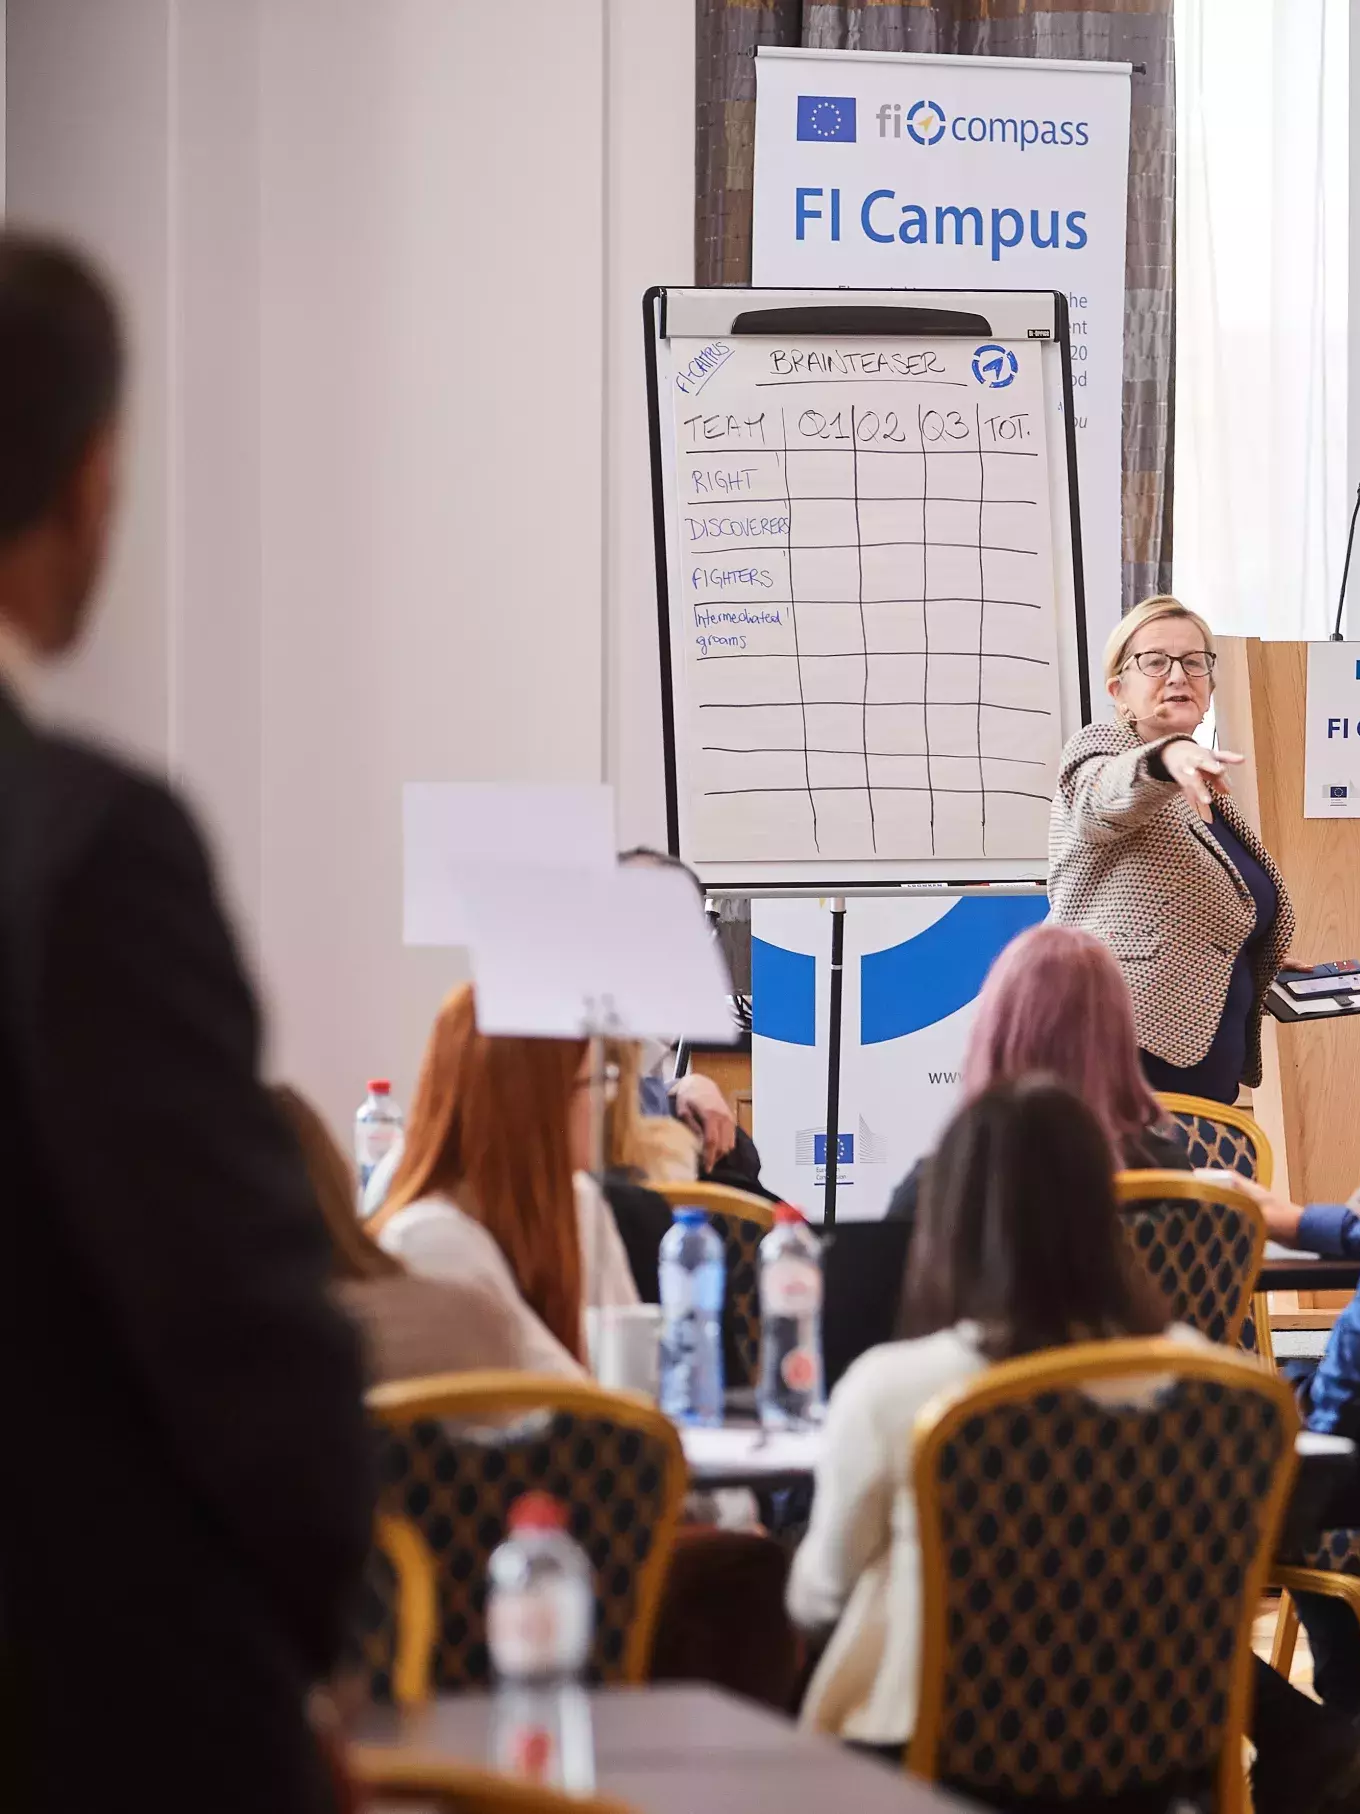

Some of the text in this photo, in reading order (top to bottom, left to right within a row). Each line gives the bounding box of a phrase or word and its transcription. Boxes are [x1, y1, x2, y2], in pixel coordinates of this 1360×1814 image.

[951, 116, 1090, 151] compass
[795, 187, 1088, 262] FI Campus
[769, 349, 946, 376] BRAINTEASER
[684, 412, 765, 445] TEAM
[798, 409, 850, 440] Q1
[856, 410, 906, 442] Q2
[922, 410, 970, 442] Q3
[692, 468, 758, 494] RIGHT
[685, 517, 790, 541] DISCOVERERS
[692, 567, 774, 589] FIGHTERS
[1327, 718, 1349, 739] FI
